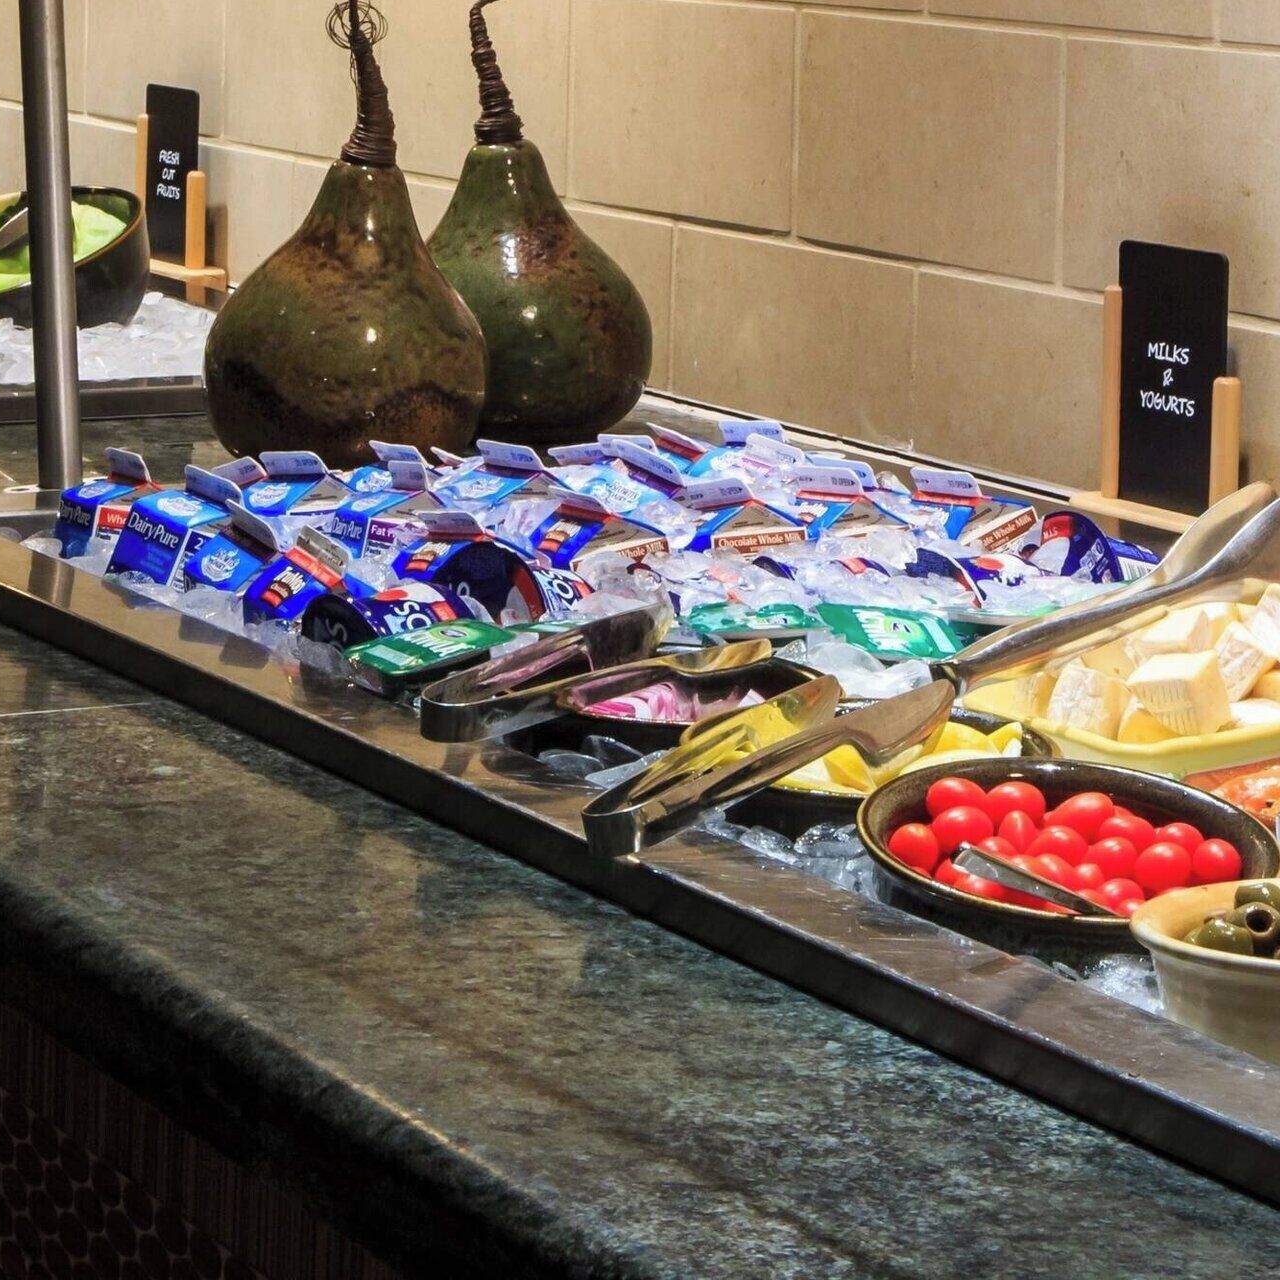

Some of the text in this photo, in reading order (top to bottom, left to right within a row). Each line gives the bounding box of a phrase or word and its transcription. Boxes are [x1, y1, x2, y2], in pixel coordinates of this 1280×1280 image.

[159, 149, 180, 165] FRESH
[156, 183, 180, 200] FRUITS
[1148, 342, 1190, 365] MILKS
[1162, 368, 1174, 387] &
[1139, 389, 1195, 417] YOGURTS
[371, 524, 386, 537] Fat
[757, 533, 785, 545] Whole
